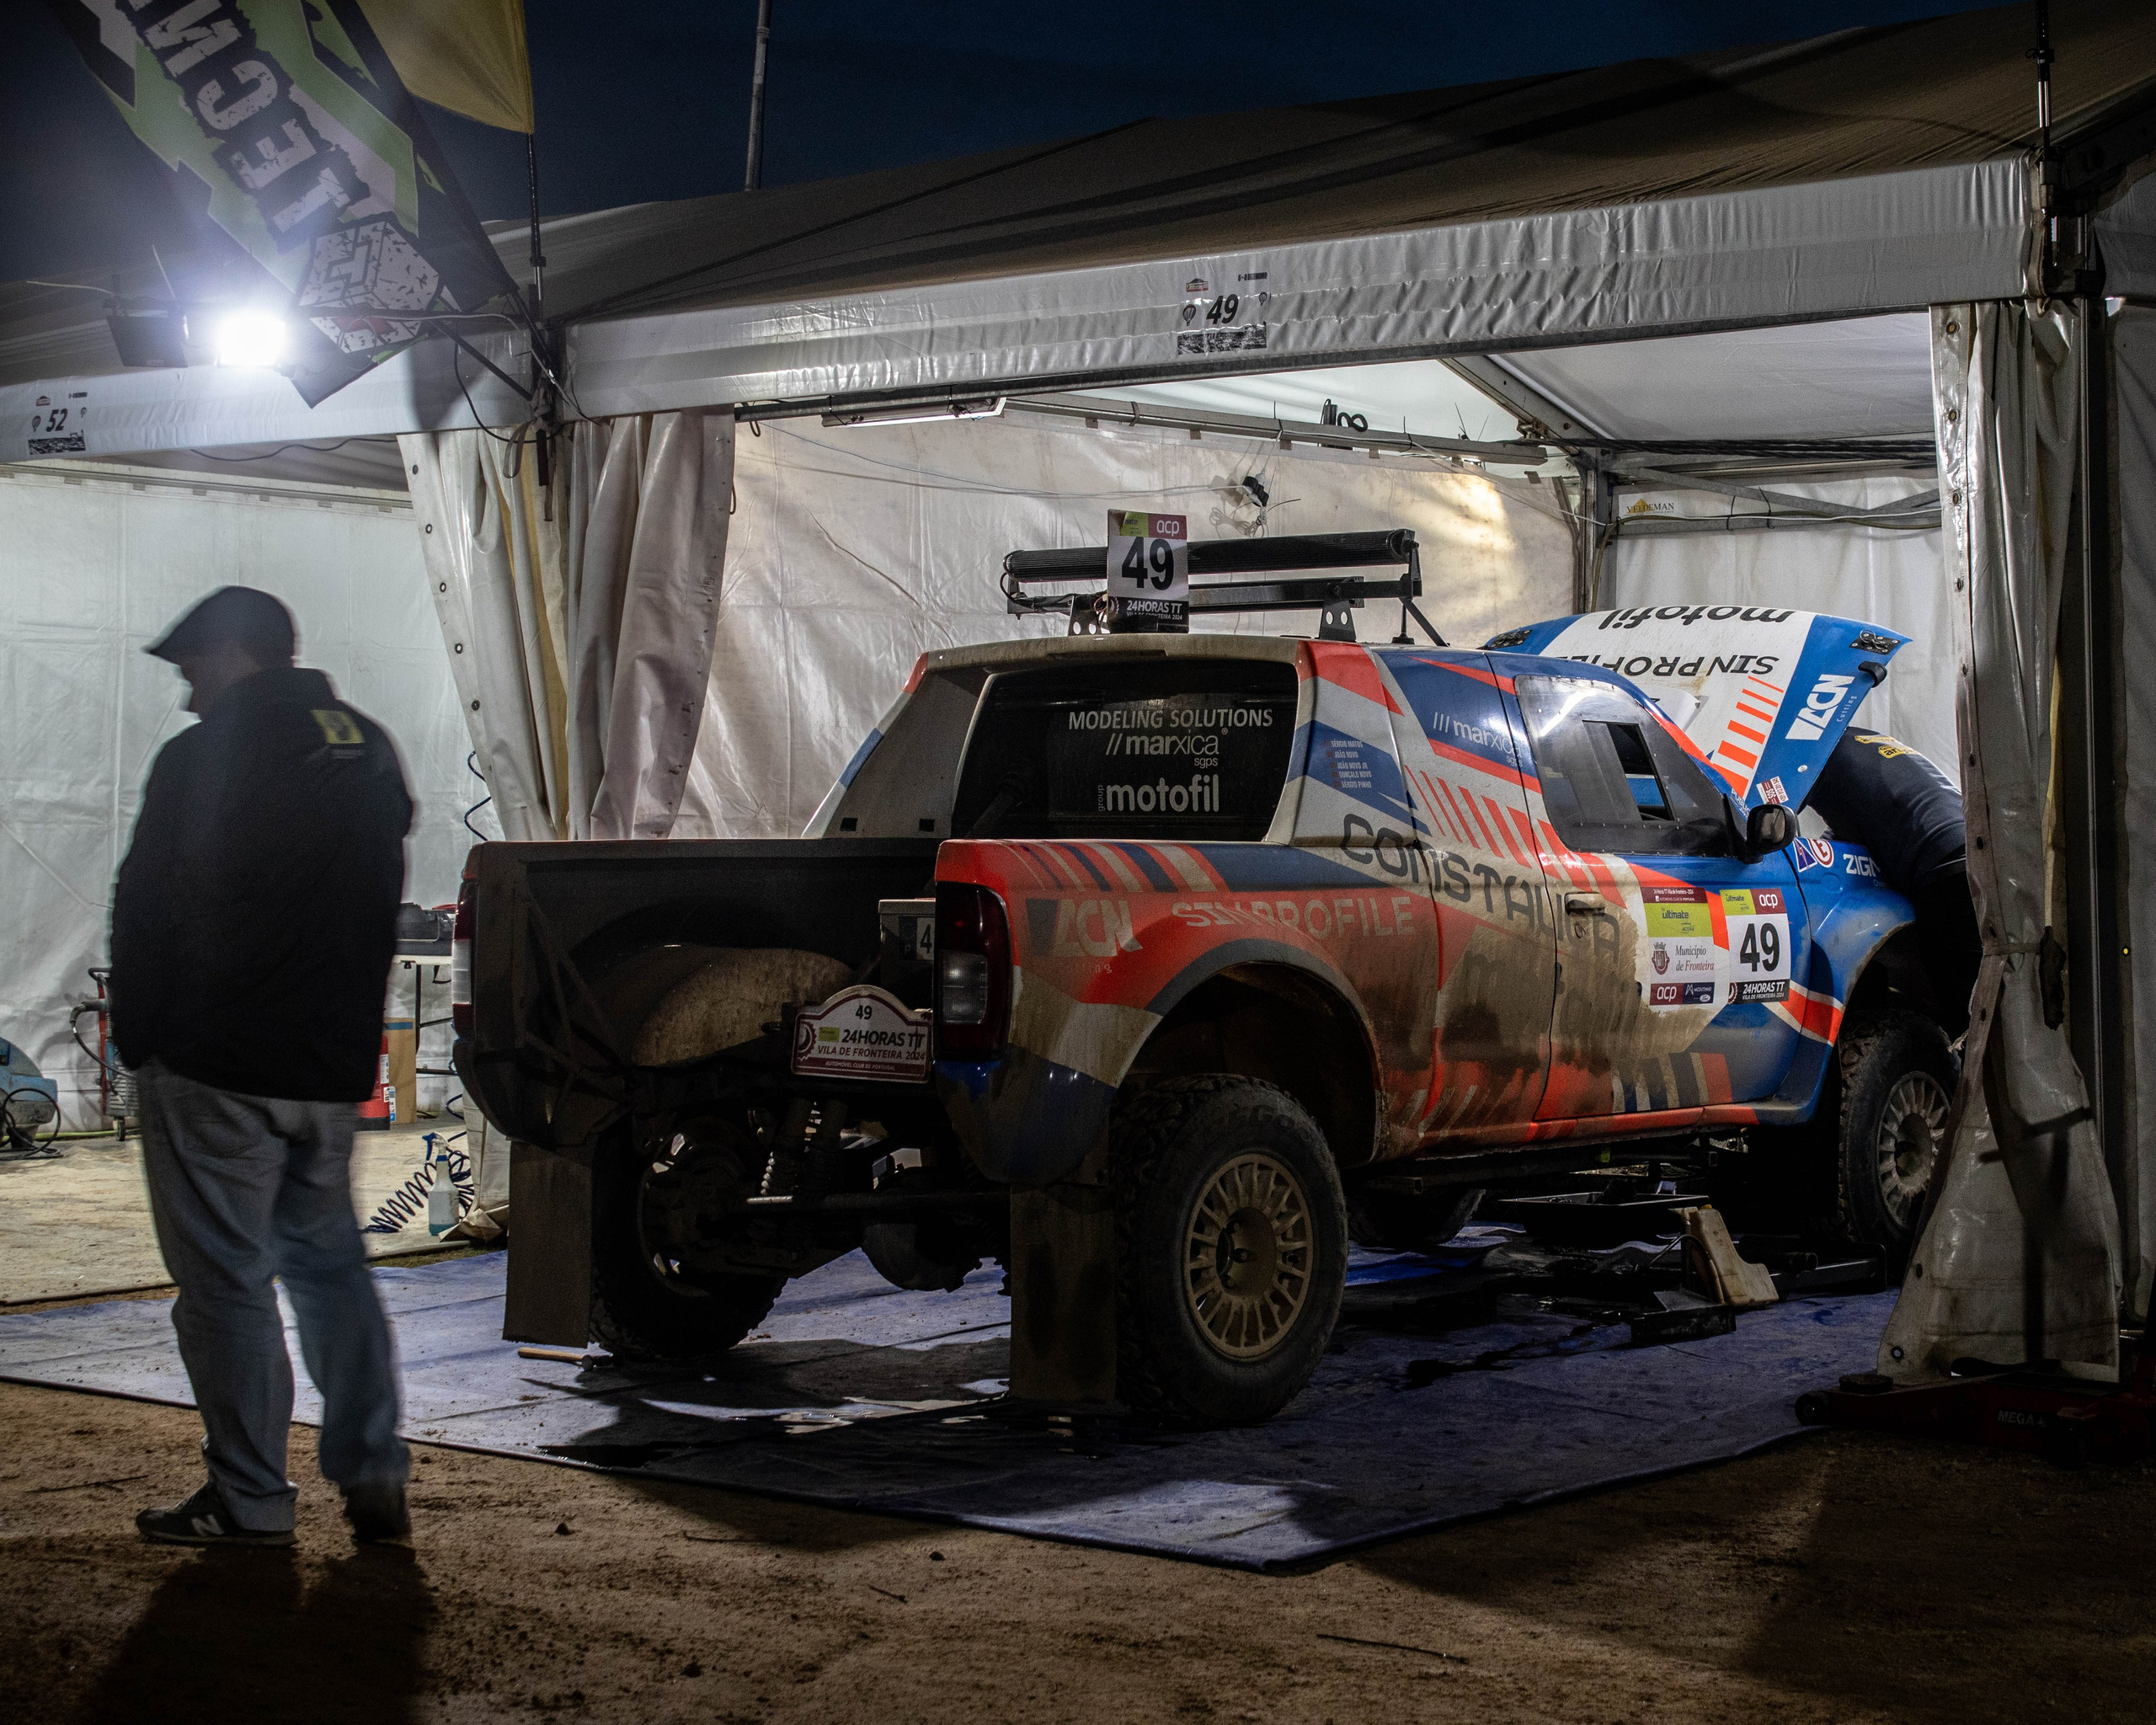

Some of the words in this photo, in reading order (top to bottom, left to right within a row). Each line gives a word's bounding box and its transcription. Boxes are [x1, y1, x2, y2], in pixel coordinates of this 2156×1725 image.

[1206, 293, 1239, 324] 49
[45, 408, 68, 432] 52
[1626, 502, 1675, 513] VELDEMAN
[1156, 520, 1180, 537] acp
[1121, 536, 1175, 590] 49
[1171, 602, 1182, 614] TT
[1598, 605, 1796, 630] motofil
[1836, 695, 1858, 723] Cutting
[1068, 710, 1164, 730] MODELING
[1169, 708, 1273, 729] SOLUTIONS
[1193, 756, 1219, 769] sgps
[1097, 784, 1106, 812] group
[1106, 773, 1219, 813] motofil
[1765, 788, 1777, 799] SOS
[1758, 894, 1779, 909] acp
[1251, 896, 1416, 940] PROFILE
[1662, 910, 1689, 920] ultimate
[1675, 944, 1707, 959] Município
[1739, 922, 1780, 972] 49
[1675, 961, 1684, 972] de
[1684, 960, 1715, 971] Fronteira
[1657, 985, 1677, 1002] acp
[1776, 981, 1785, 992] TT
[855, 1004, 873, 1020] 49
[908, 1032, 926, 1048] TT
[818, 1045, 837, 1055] VILA
[838, 1046, 851, 1056] DE
[852, 1047, 902, 1060] FRONTEIRA
[905, 1050, 926, 1061] 2024
